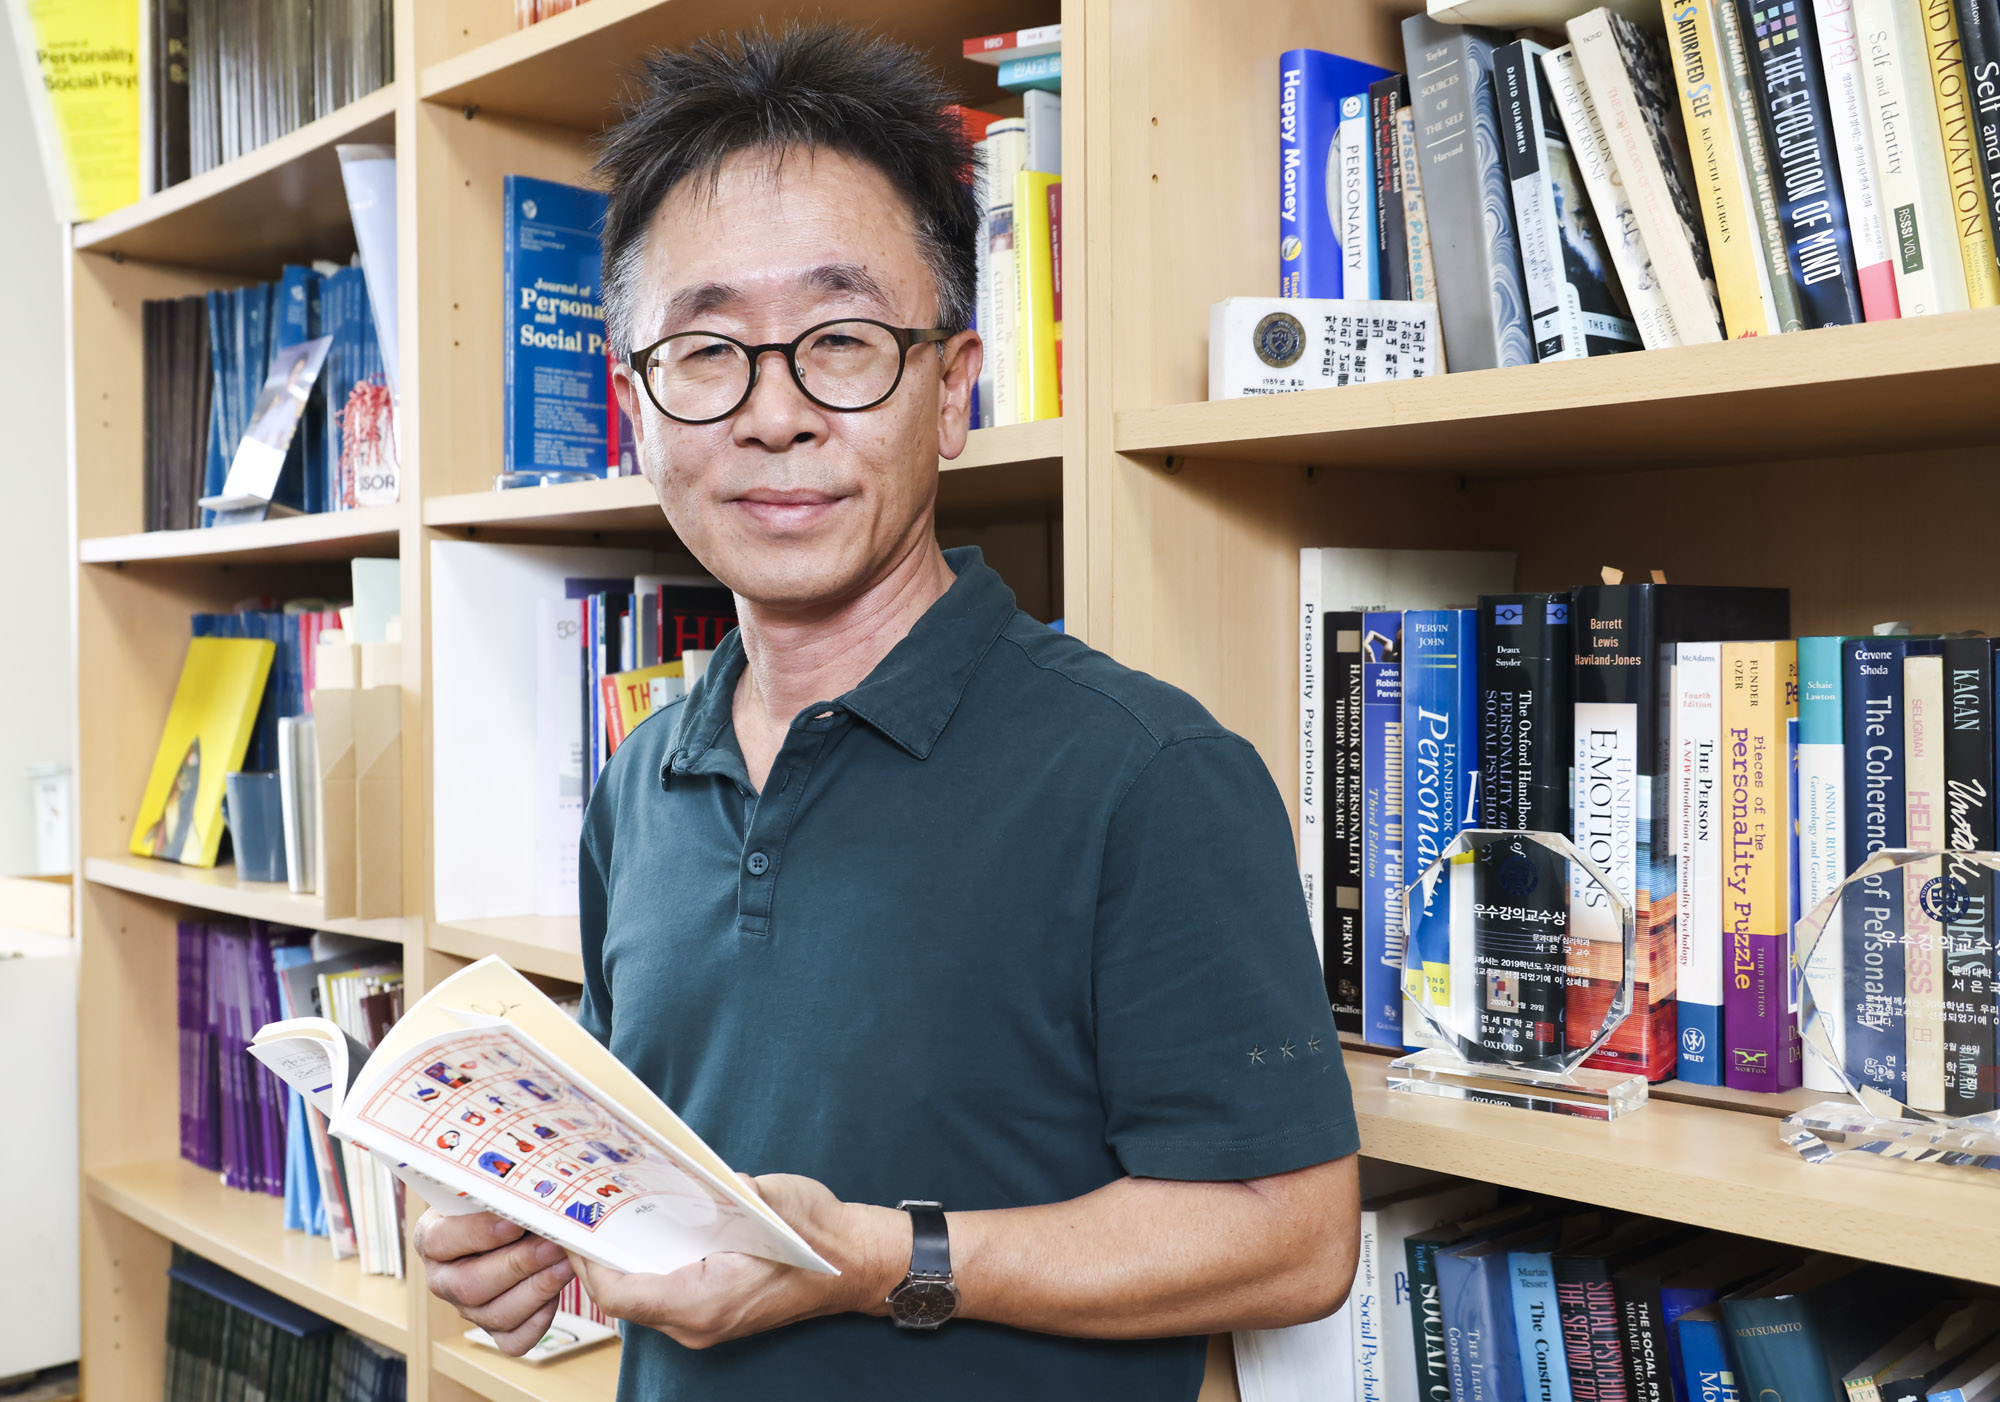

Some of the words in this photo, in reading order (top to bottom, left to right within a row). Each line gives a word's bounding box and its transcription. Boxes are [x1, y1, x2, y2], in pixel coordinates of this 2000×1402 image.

[37, 48, 135, 66] Personality
[1424, 47, 1448, 63] Taylor
[1673, 6, 1705, 84] SATURATED
[1870, 30, 1892, 68] Self
[43, 75, 99, 93] Social
[1506, 66, 1518, 98] DAVID
[1763, 46, 1807, 94] THE
[1875, 74, 1890, 97] and
[1421, 75, 1459, 98] SOURCES
[1687, 83, 1713, 118] SELF
[1281, 69, 1300, 143] Happy
[1389, 92, 1398, 127] George
[1436, 99, 1449, 111] OF
[1424, 123, 1444, 137] THE
[1445, 113, 1465, 127] SELF
[1510, 101, 1527, 154] QUAMMEN
[1559, 76, 1577, 106] FOR
[1570, 107, 1606, 182] EVERYONE
[1576, 80, 1614, 163] EVOLUTION
[1391, 129, 1399, 166] Herbert
[1433, 143, 1464, 165] Harvard
[1615, 108, 1645, 173] PSYCHOLOGY
[1720, 3, 1747, 77] GOFFMAN
[1738, 89, 1767, 172] STRATEGIC
[1755, 173, 1789, 276] INTERACTION
[1770, 88, 1827, 203] EVOLUTION
[1880, 100, 1903, 176] Identity
[1933, 38, 1984, 239] MOTIVATION
[1393, 168, 1401, 193] Mead
[1401, 120, 1419, 212] Pascal's
[1282, 149, 1300, 222] Money
[1701, 127, 1720, 182] KENNETH
[1715, 196, 1731, 244] GERGEN
[1346, 145, 1360, 270] PERSONALITY
[1791, 200, 1832, 228] OF
[1898, 208, 1914, 239] RSSSI
[1525, 232, 1539, 281] DARWIN
[1535, 220, 1551, 289] RELUCTANT
[1796, 228, 1842, 286] MIND
[1903, 239, 1917, 262] VOL.
[1972, 241, 1985, 300] PSYCHOLOGICAL
[534, 278, 577, 296] Journal
[579, 285, 591, 297] of
[534, 312, 556, 325] and
[1567, 293, 1577, 323] GREAT
[520, 325, 582, 351] Social
[1588, 319, 1604, 331] THE
[1653, 308, 1668, 342] Sloan
[1415, 623, 1449, 633] PERVIN
[1590, 618, 1622, 630] Barrett
[1304, 603, 1315, 700] Personality
[1418, 637, 1445, 648] JOHN
[1497, 646, 1520, 655] Deaux
[1593, 636, 1619, 648] Lewis
[1855, 650, 1892, 660] Cervone
[1379, 668, 1399, 678] John
[1496, 659, 1521, 668] Snyder
[1574, 654, 1642, 666] Haviland-Jones
[1681, 654, 1716, 663] McAdams
[1860, 665, 1888, 675] Shoda
[1735, 660, 1743, 690] OZER
[1750, 660, 1759, 708] FUNDER
[1807, 681, 1833, 690] Schaie
[1350, 664, 1361, 746] HANDBOOK
[1519, 691, 1532, 717] The
[1683, 700, 1712, 709] Edition
[1684, 692, 1711, 700] Fourth
[1805, 692, 1836, 701] Lawton
[1953, 668, 1980, 731] KAGAN
[1336, 698, 1346, 747] THEORY
[1485, 690, 1498, 751] SOCIAL
[1865, 695, 1892, 736] The
[1911, 698, 1924, 758] SELIGMAN
[1304, 709, 1315, 806] Psychology
[1500, 690, 1513, 809] PERSONALITY
[1519, 719, 1533, 767] Oxford
[1699, 740, 1714, 774] THE
[1336, 751, 1346, 772] AND
[1350, 751, 1361, 770] OF
[1684, 750, 1692, 775] NEW
[1753, 735, 1766, 788] Pieces
[1444, 743, 1456, 833] HANDBOOK
[1305, 815, 1315, 824] 2
[1336, 775, 1346, 839] RESEARCH
[1368, 788, 1378, 826] Third
[1615, 758, 1632, 872] HANDBOOK
[1683, 778, 1692, 839] Introduction
[1698, 779, 1713, 842] PERSON
[1728, 727, 1755, 895] Personality
[1754, 797, 1767, 815] of
[1810, 775, 1821, 837] Gerontology
[1825, 782, 1836, 833] ANNUAL
[1349, 774, 1361, 877] PERSONALITY
[1754, 825, 1767, 851] the
[1368, 829, 1380, 878] Edition
[1683, 842, 1690, 852] to
[1810, 840, 1818, 857] and
[1825, 835, 1836, 889] REVIEW
[1681, 855, 1691, 911] Personality
[1863, 874, 1891, 900] of
[1474, 904, 1566, 925] 우수강의교수상
[1342, 916, 1353, 966] PERVIN
[1533, 934, 1560, 943] 문과대학
[1562, 937, 1590, 946] 심리학과
[1680, 912, 1691, 967] Psychology
[1734, 902, 1755, 990] Puzzle
[1501, 959, 1542, 970] 2019학년도
[1544, 963, 1590, 976] 우리대학교의
[1505, 970, 1551, 983] 선정되었기에
[1757, 947, 1765, 976] THIRD
[1758, 979, 1766, 1018] EDITION
[1483, 1039, 1523, 1053] OXFORD
[1682, 1053, 1705, 1063] WILEY
[1735, 1066, 1767, 1074] NORTON
[1416, 1245, 1428, 1273] Taylor
[1518, 1268, 1548, 1277] Martin
[1520, 1279, 1548, 1288] Tesser
[1557, 1281, 1585, 1310] THE
[1360, 1294, 1377, 1340] Social
[1530, 1301, 1546, 1332] The
[1586, 1281, 1619, 1337] SOCIAL
[1637, 1301, 1650, 1328] THE
[1420, 1283, 1447, 1377] SOCIAL
[1467, 1330, 1481, 1358] THE
[1735, 1322, 1802, 1338] MATSUMOTO
[1625, 1300, 1641, 1353] MICHAEL
[1633, 1356, 1648, 1402] ARGYLE
[1642, 1331, 1657, 1378] SOCIAL
